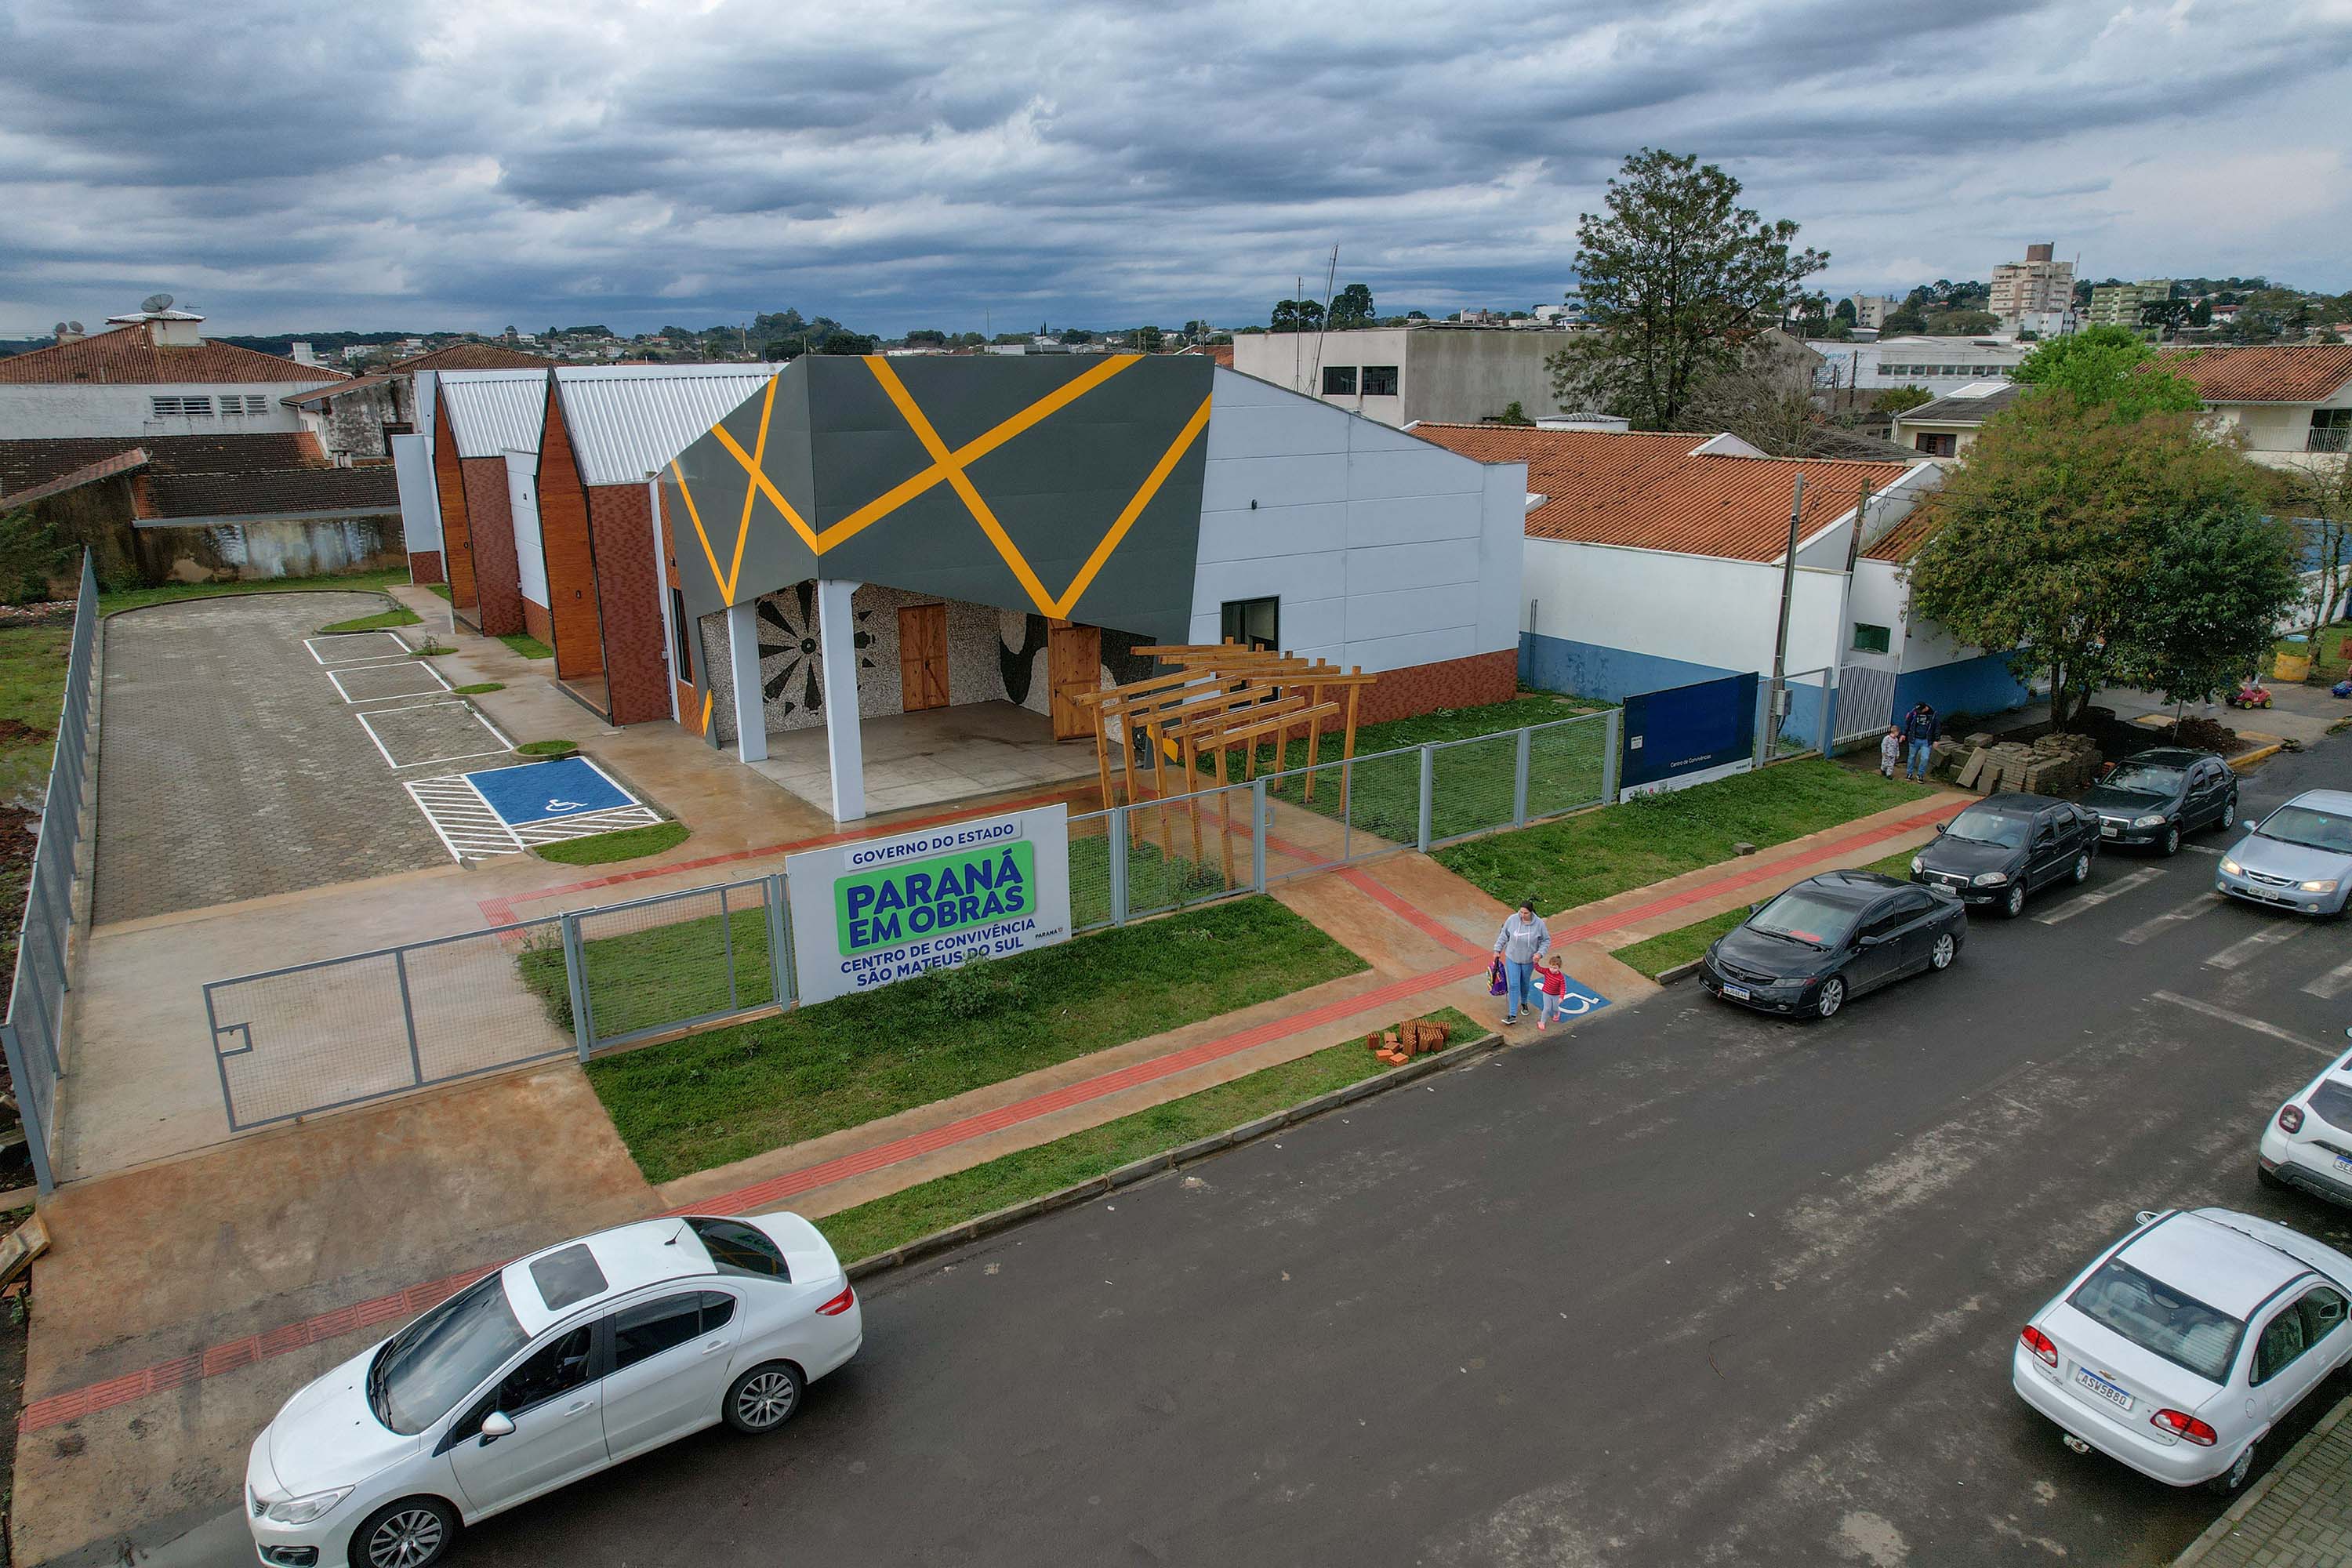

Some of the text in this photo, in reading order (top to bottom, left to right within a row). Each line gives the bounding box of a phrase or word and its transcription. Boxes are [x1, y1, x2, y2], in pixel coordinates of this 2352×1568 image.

[852, 824, 1014, 864] GOVERNO DO ESTADO
[847, 848, 1023, 920] PARANÁ
[848, 885, 1025, 948] EM OBRAS
[840, 918, 1036, 974] CENTRO DE CONVIVÊNCIA
[856, 936, 1024, 986] SÃO MATEUS DO SUL
